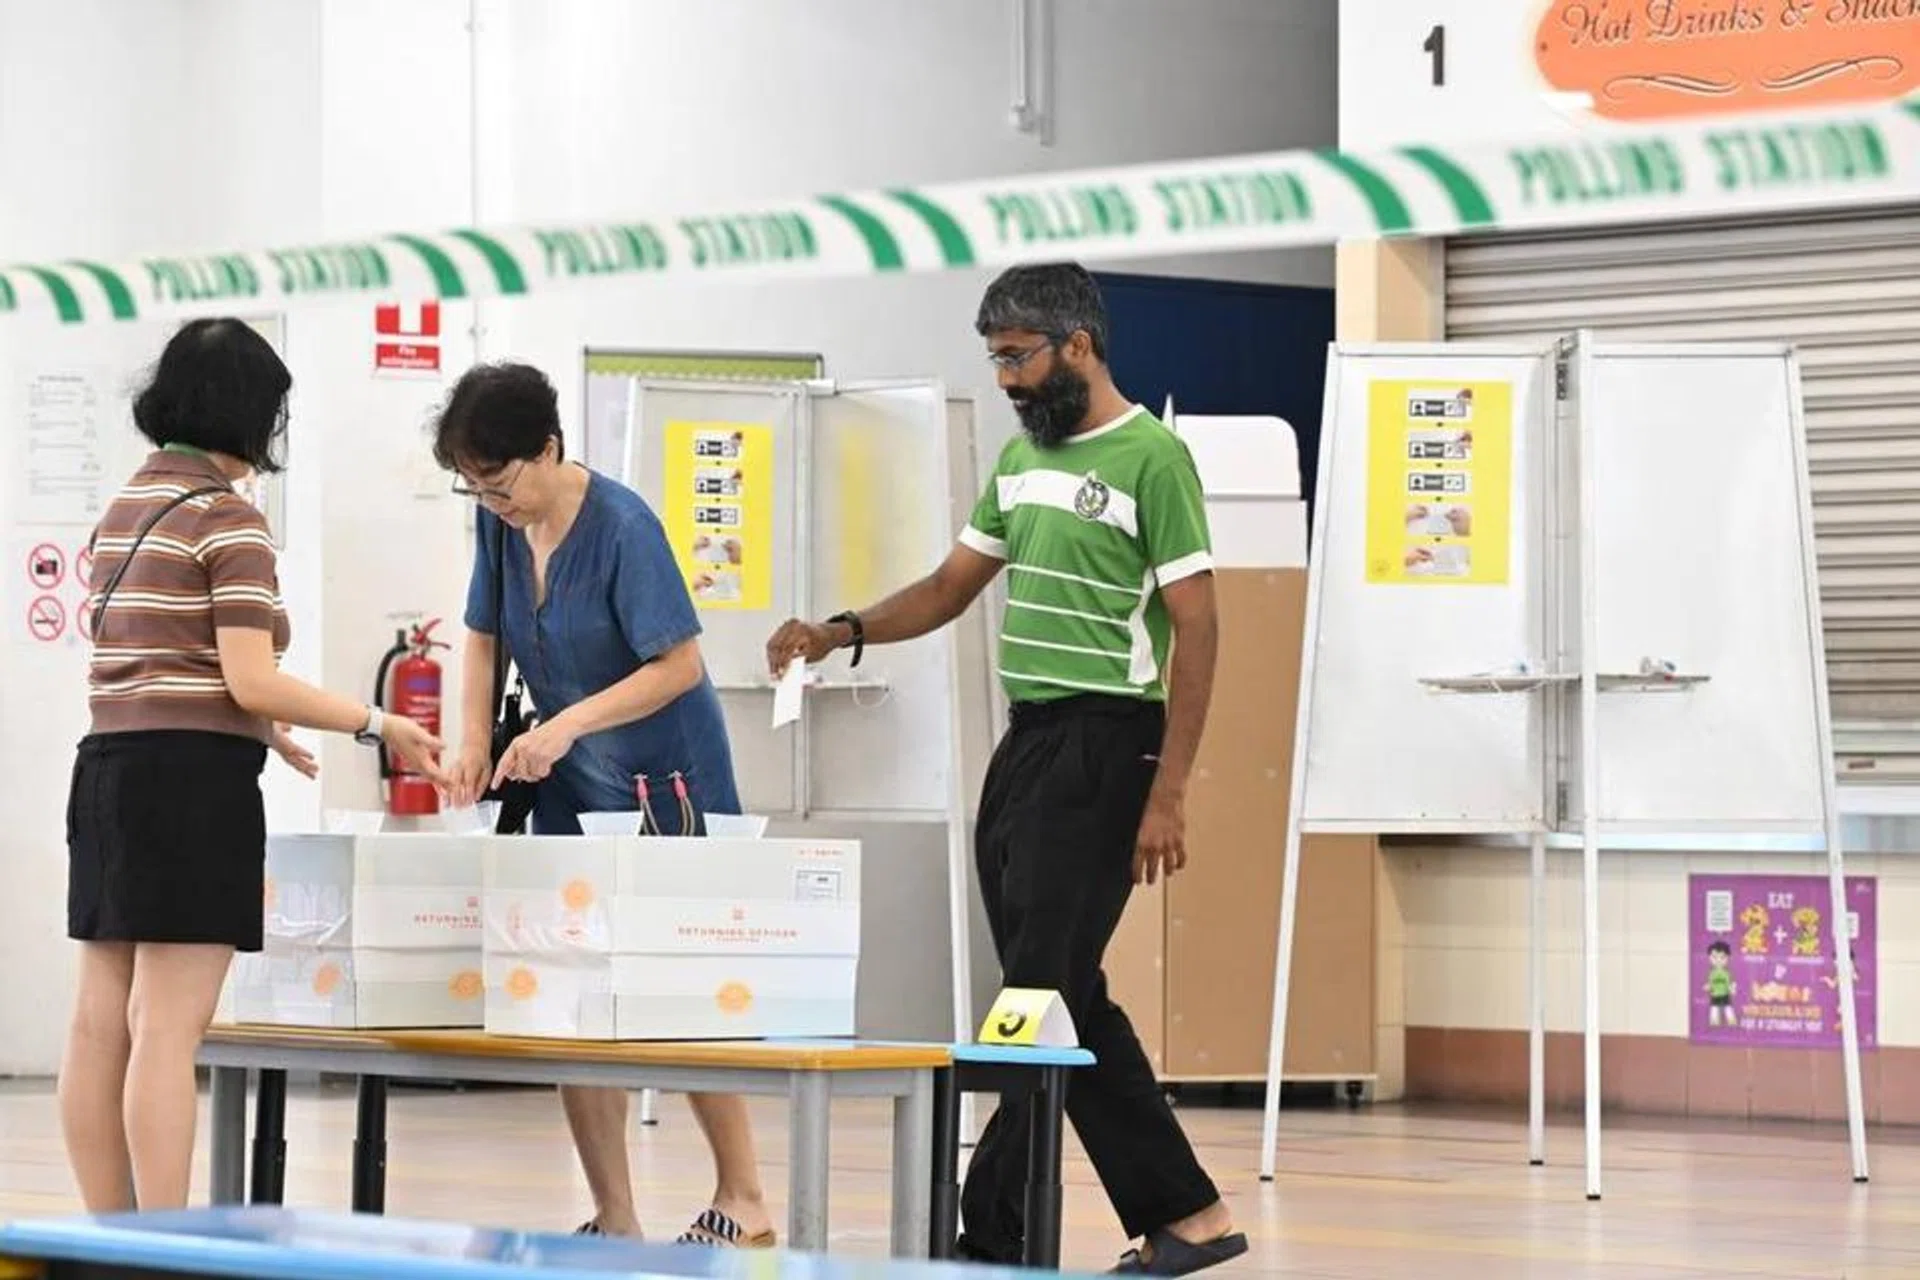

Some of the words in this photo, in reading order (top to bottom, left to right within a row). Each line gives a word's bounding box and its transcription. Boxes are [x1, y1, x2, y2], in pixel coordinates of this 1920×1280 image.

[1562, 3, 1633, 45] Hot
[1645, 0, 1763, 37] Drinks
[1423, 24, 1446, 87] 1
[1511, 139, 1684, 202] POLLING
[1707, 121, 1889, 189] STATION
[987, 184, 1139, 245] POLLING
[1152, 169, 1314, 234] STATION
[146, 253, 259, 301] POLLING
[270, 243, 390, 293] STATION
[535, 222, 667, 276] POLLING
[680, 210, 817, 267] STATION
